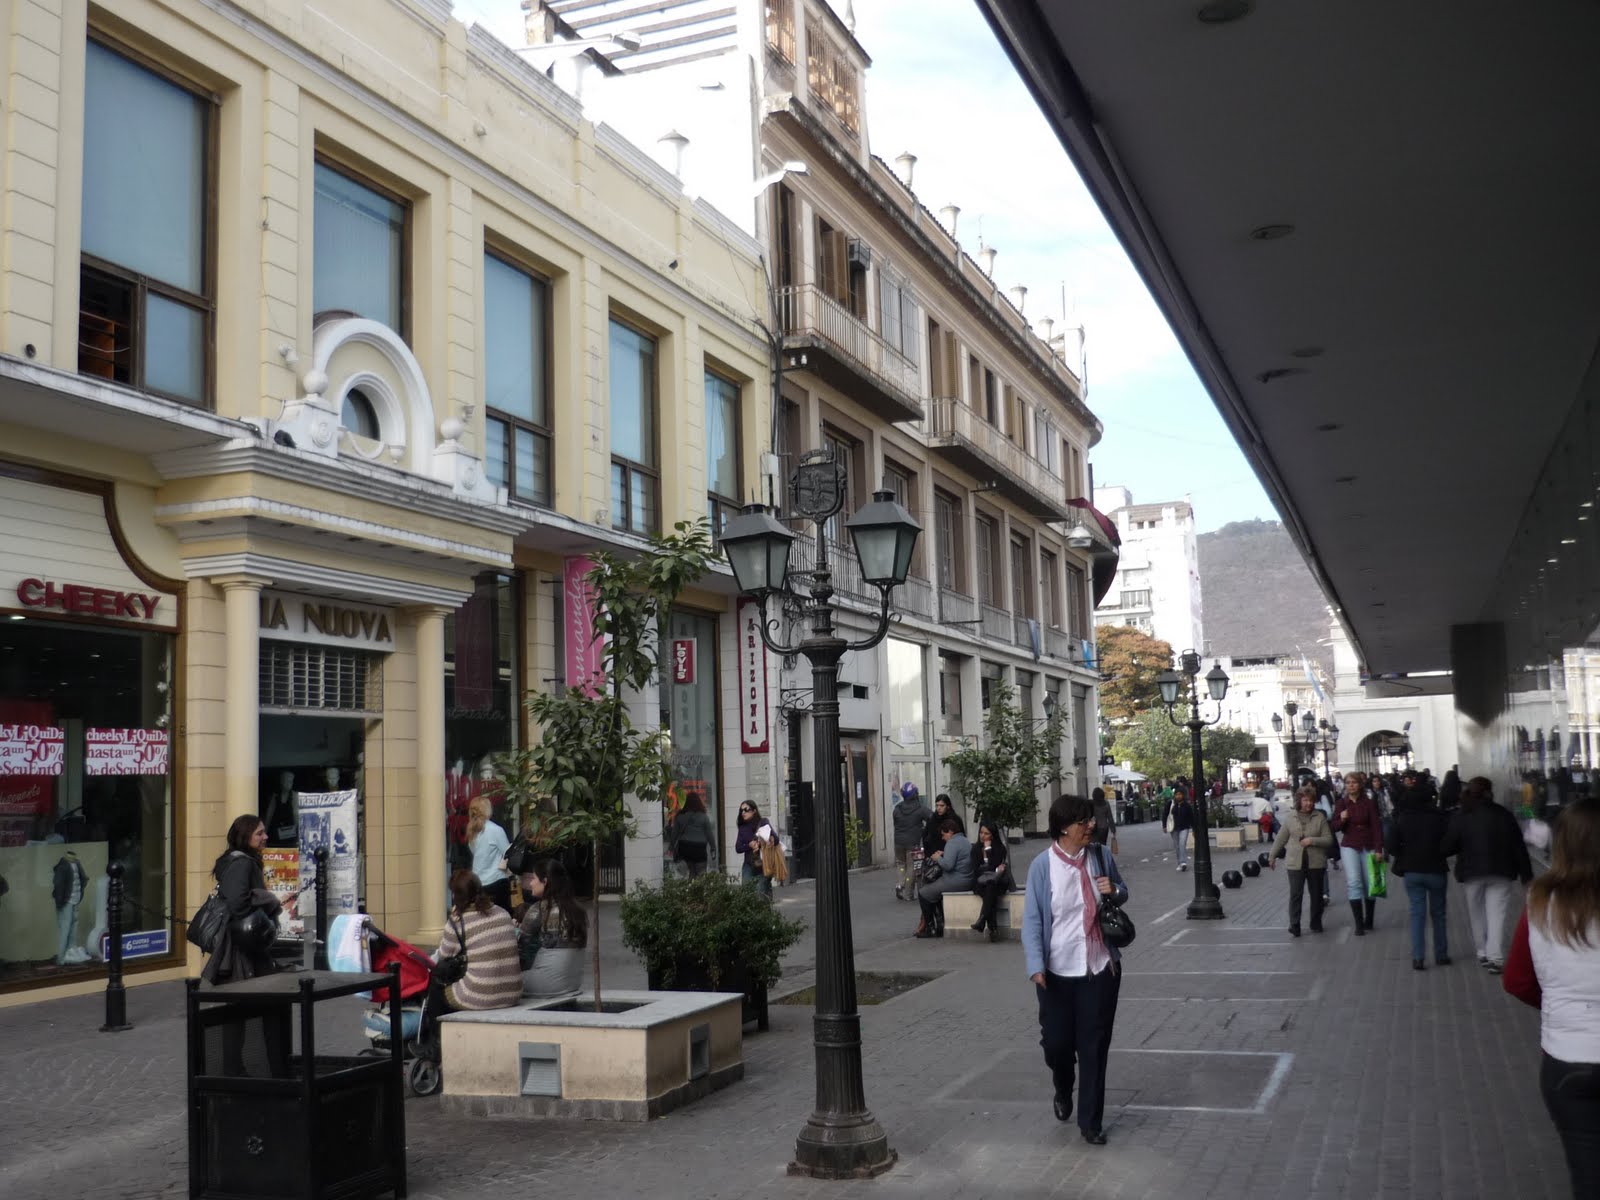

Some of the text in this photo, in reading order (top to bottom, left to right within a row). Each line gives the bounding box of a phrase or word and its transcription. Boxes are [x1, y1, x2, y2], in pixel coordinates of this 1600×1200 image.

[17, 578, 161, 620] CHEEKY
[303, 601, 393, 643] NUOVA
[746, 617, 759, 735] ARIZONA
[126, 940, 133, 950] 6
